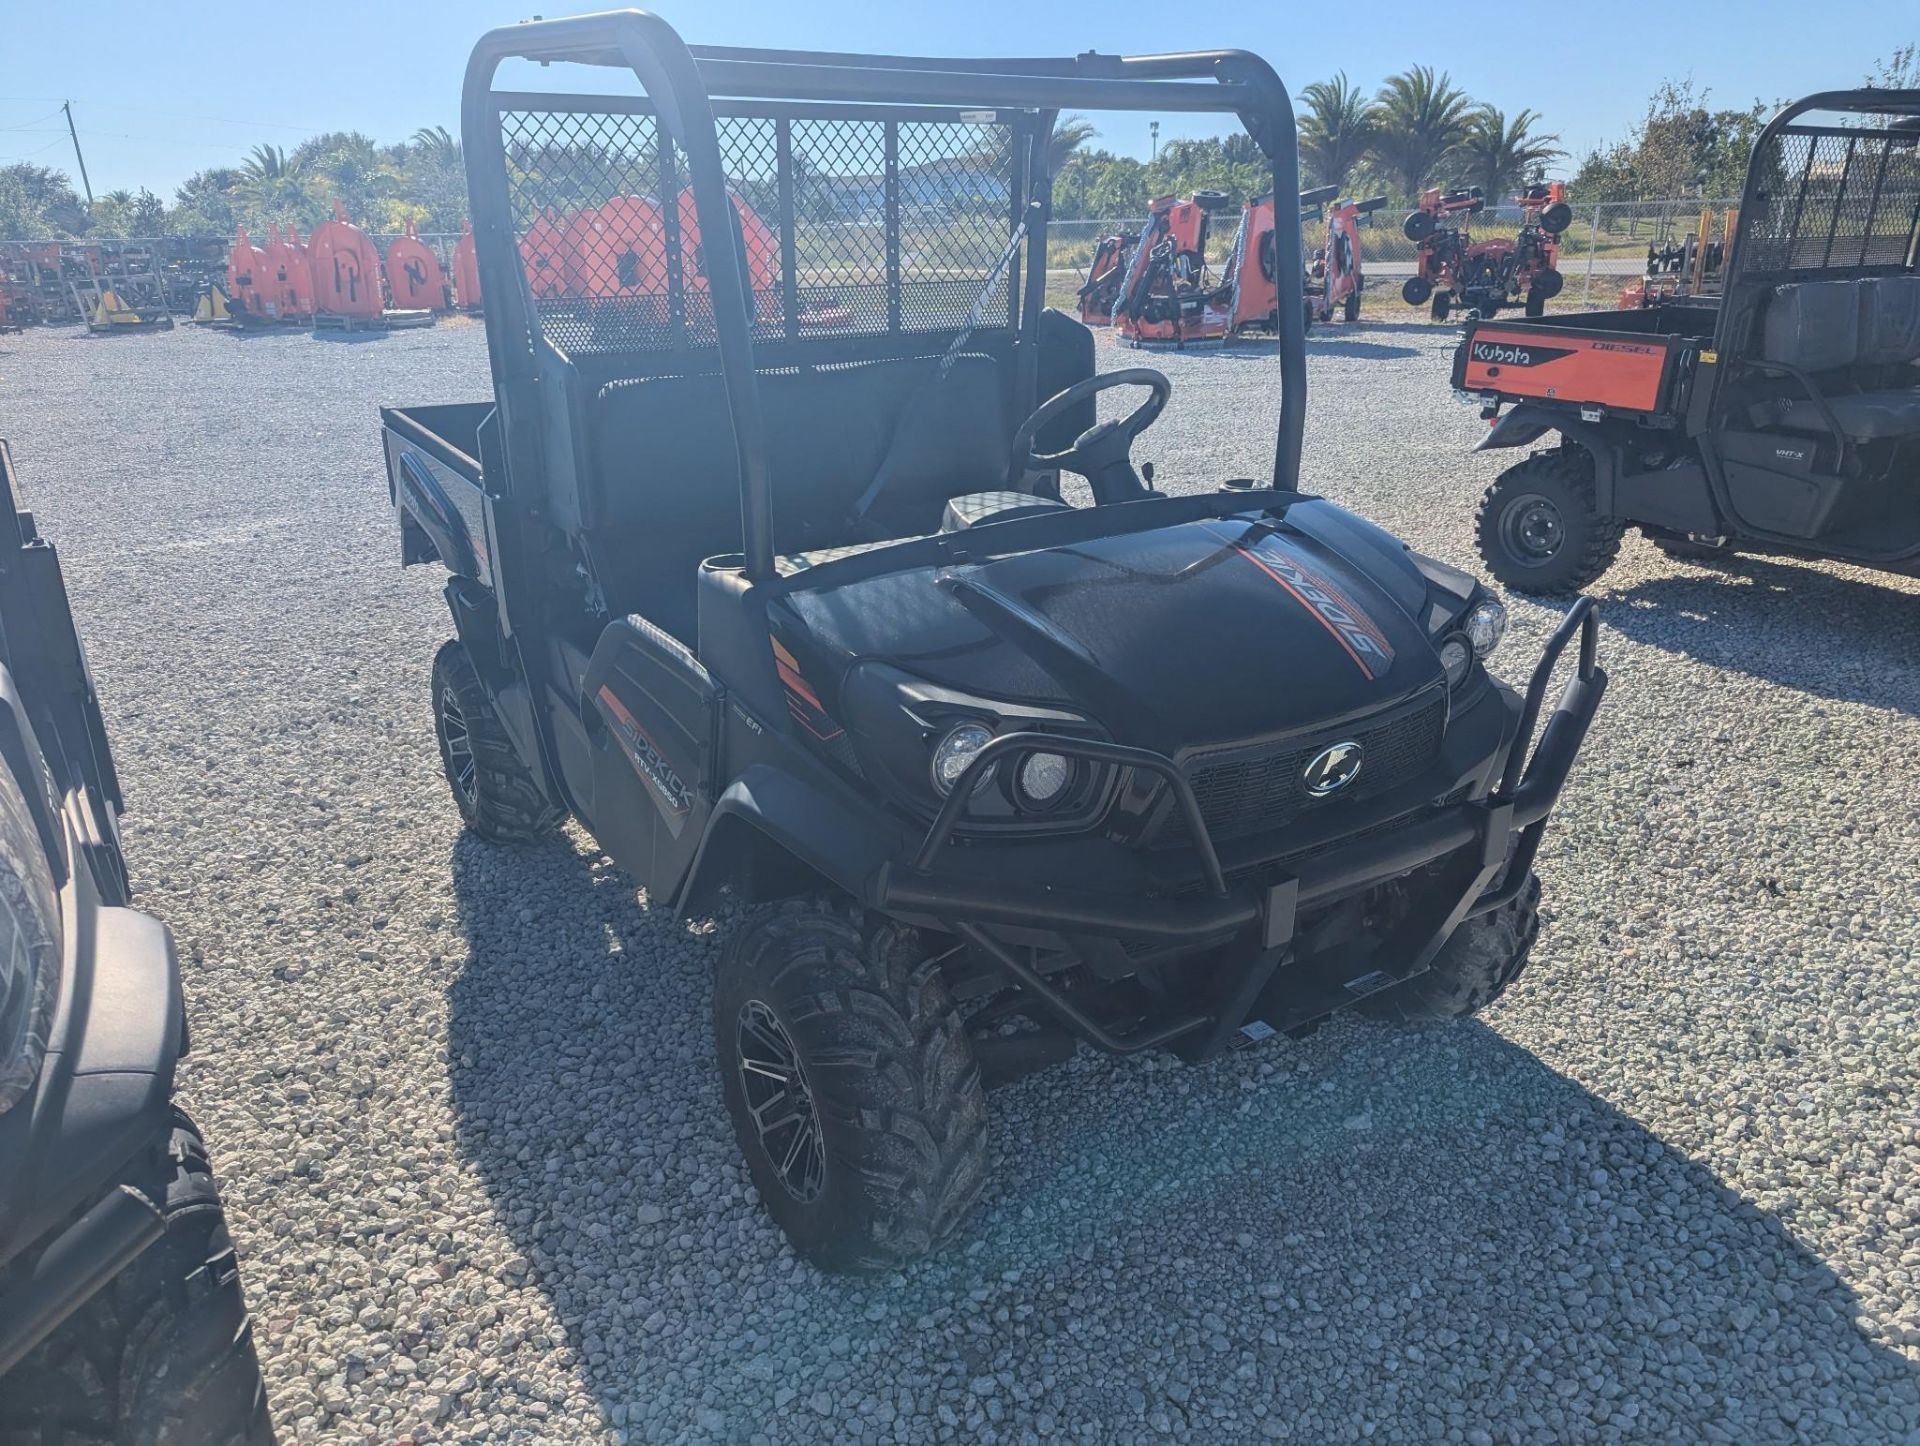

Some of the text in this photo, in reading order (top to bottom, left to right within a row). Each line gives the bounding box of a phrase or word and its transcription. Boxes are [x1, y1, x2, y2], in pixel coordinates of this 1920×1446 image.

[1474, 342, 1530, 365] Kubota
[1592, 342, 1657, 355] DIESEL
[746, 716, 762, 735] EFI
[622, 719, 694, 807] SIDEKICK
